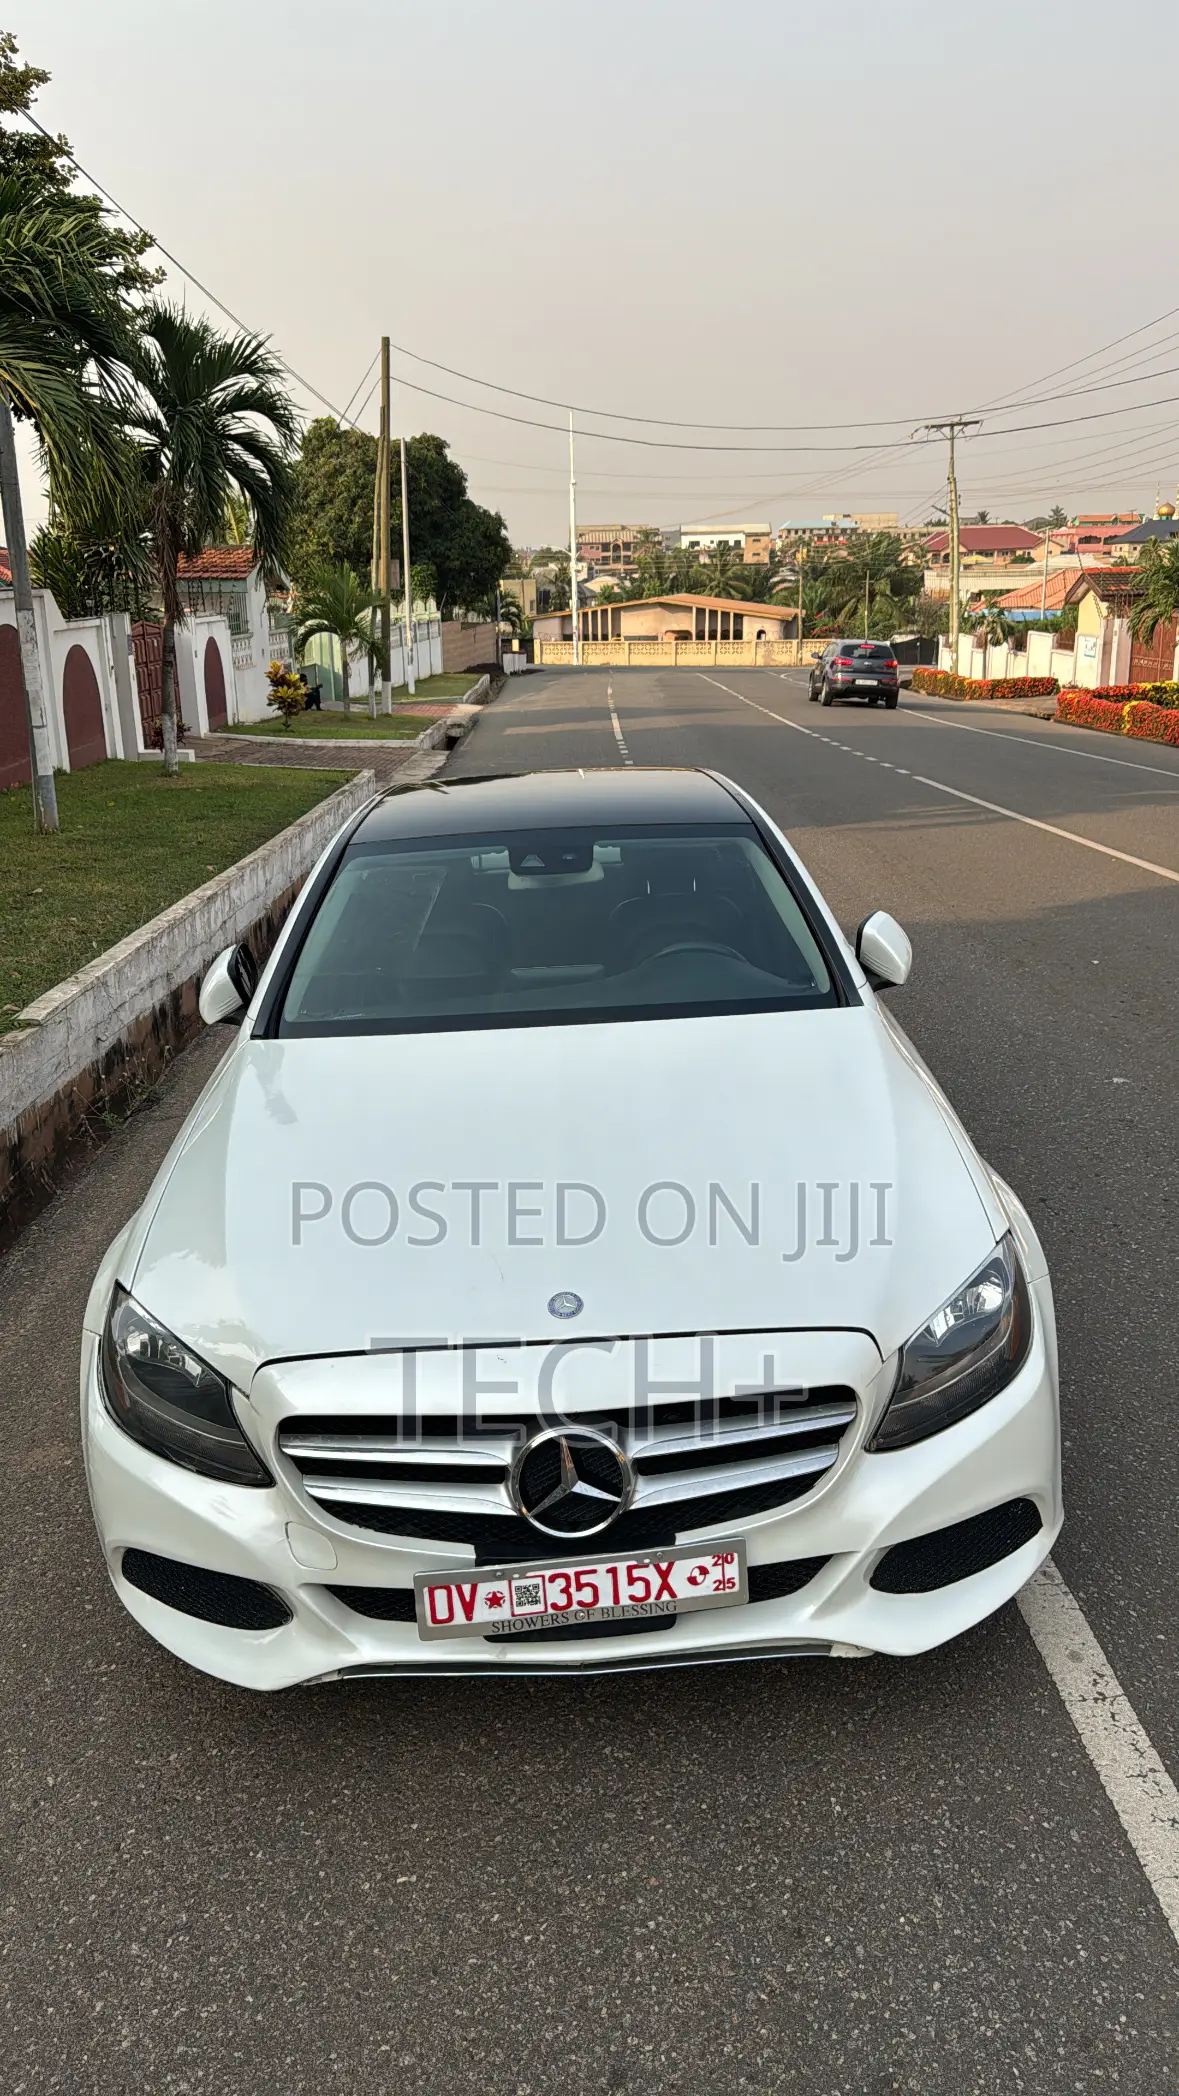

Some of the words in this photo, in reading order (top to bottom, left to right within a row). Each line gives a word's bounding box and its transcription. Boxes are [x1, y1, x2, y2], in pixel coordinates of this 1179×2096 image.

[548, 1561, 677, 1611] 3515X
[491, 1611, 570, 1634] SHOWERS
[574, 1608, 596, 1622] OF
[601, 1601, 678, 1619] BLESSING
